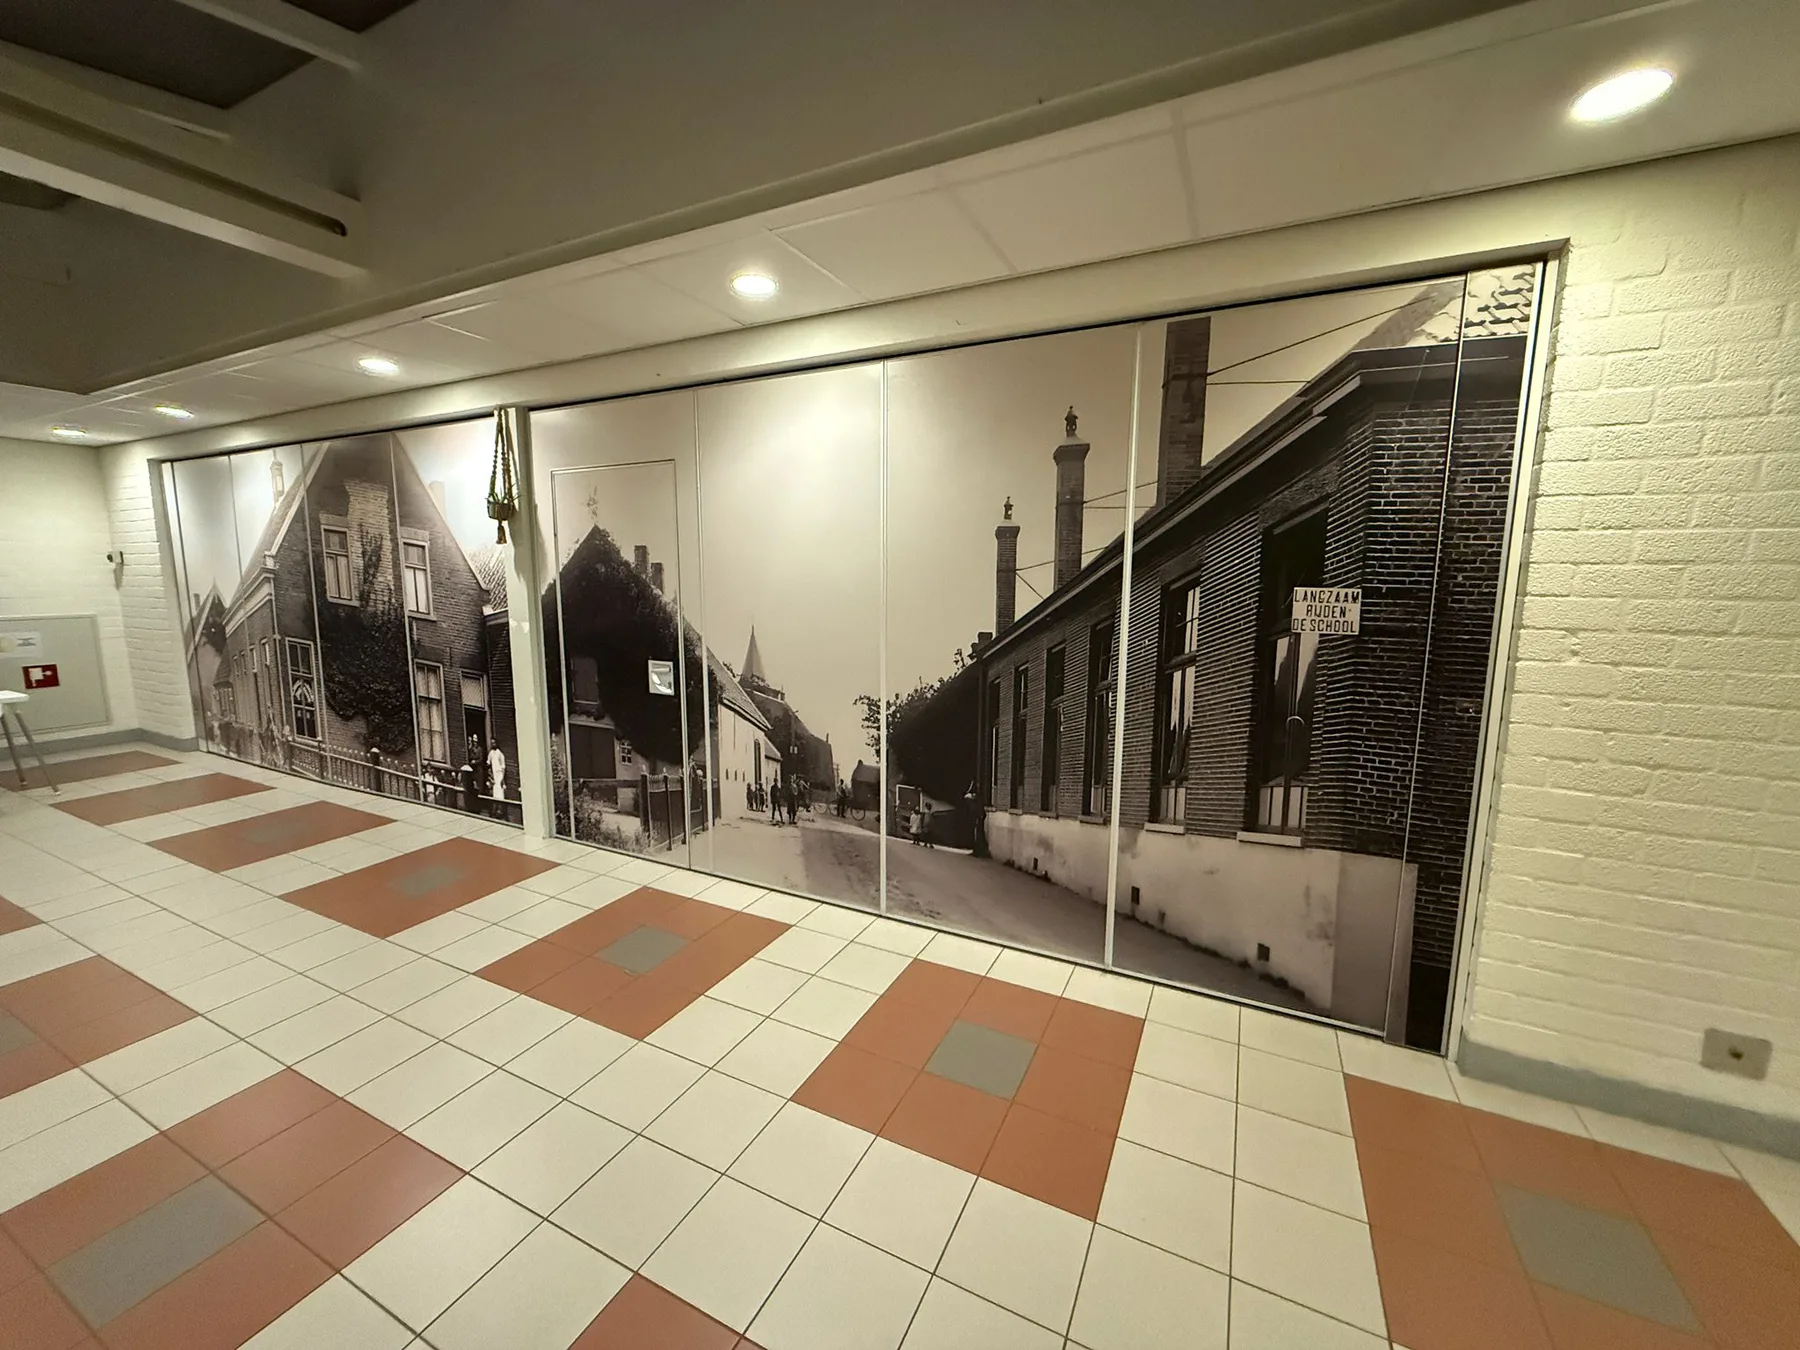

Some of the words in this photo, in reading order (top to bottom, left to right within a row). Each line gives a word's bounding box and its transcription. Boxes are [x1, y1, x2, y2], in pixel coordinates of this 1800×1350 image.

[1294, 589, 1360, 604] LANGZAAM
[1292, 618, 1307, 631] DE
[1310, 619, 1357, 633] SCHOOL
